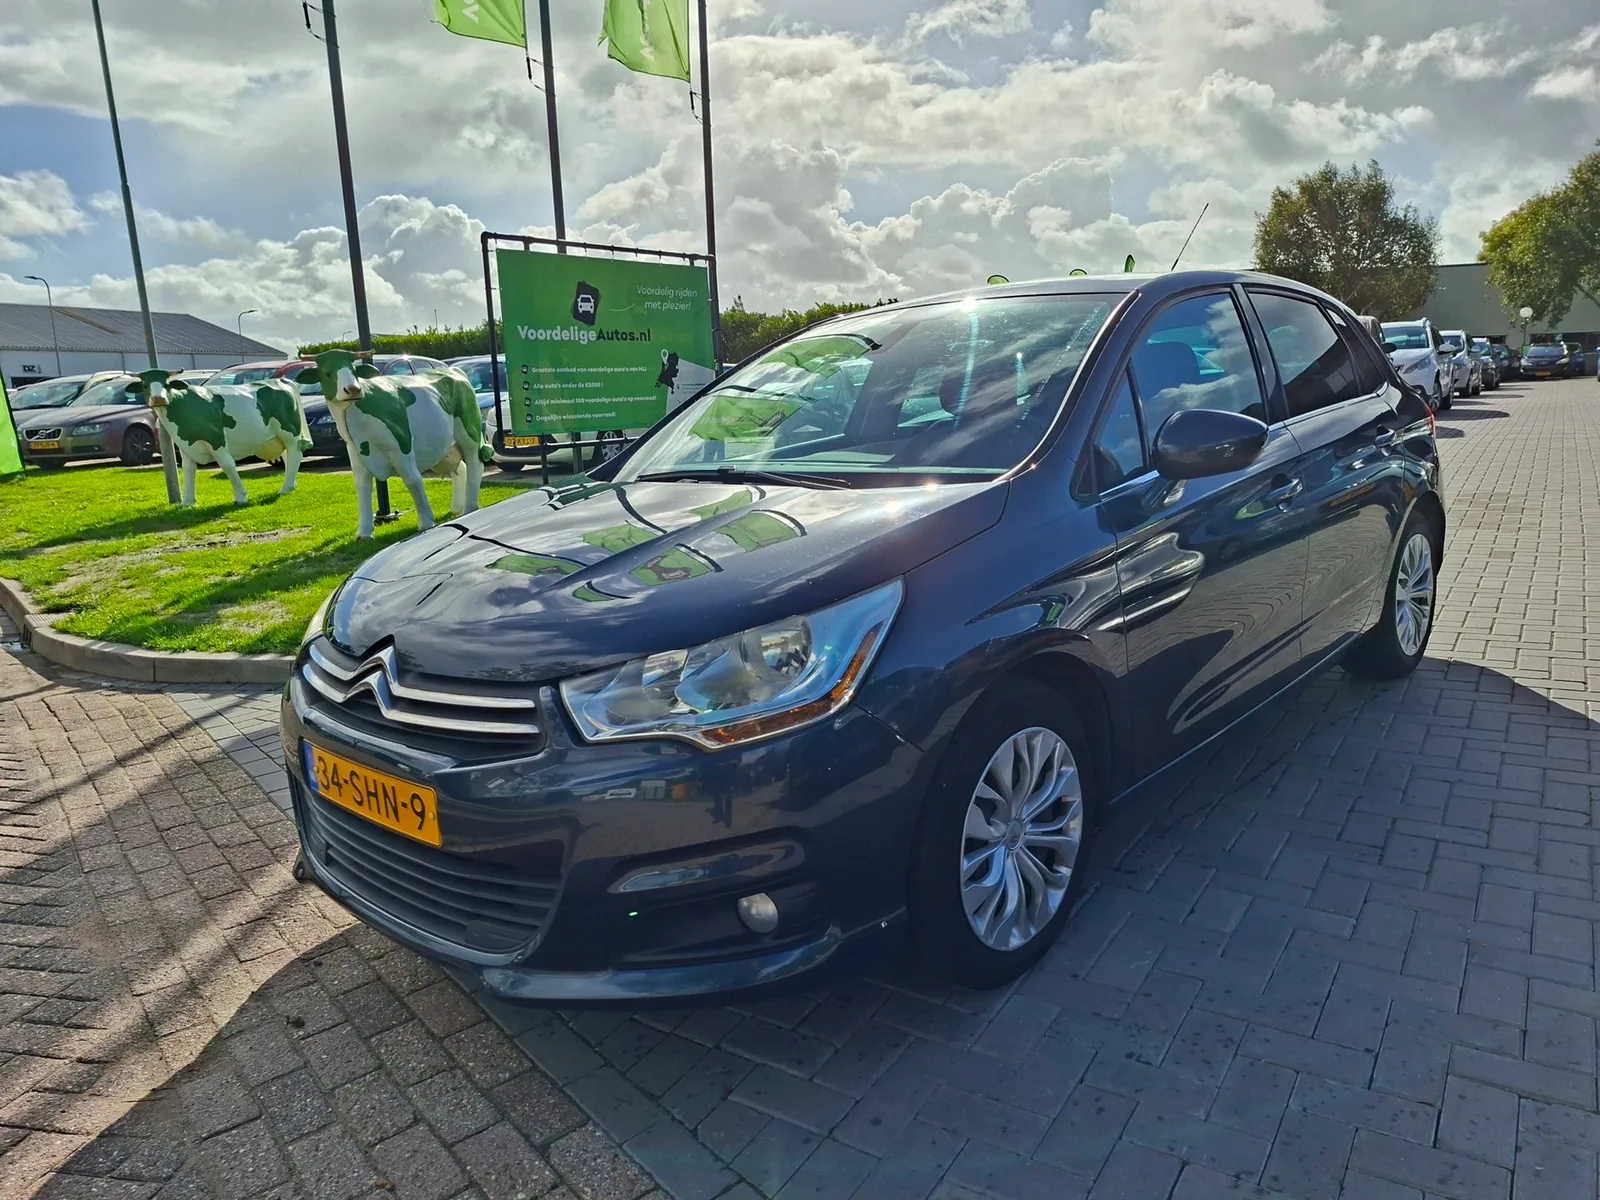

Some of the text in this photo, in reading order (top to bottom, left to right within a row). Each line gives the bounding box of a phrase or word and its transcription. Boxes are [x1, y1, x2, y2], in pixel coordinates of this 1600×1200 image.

[636, 285, 698, 299] Voordelig rijden
[644, 300, 692, 312] met plezier!
[516, 325, 652, 345] VoordeligeAutos.nl
[317, 755, 426, 831] 34-SHN-9
